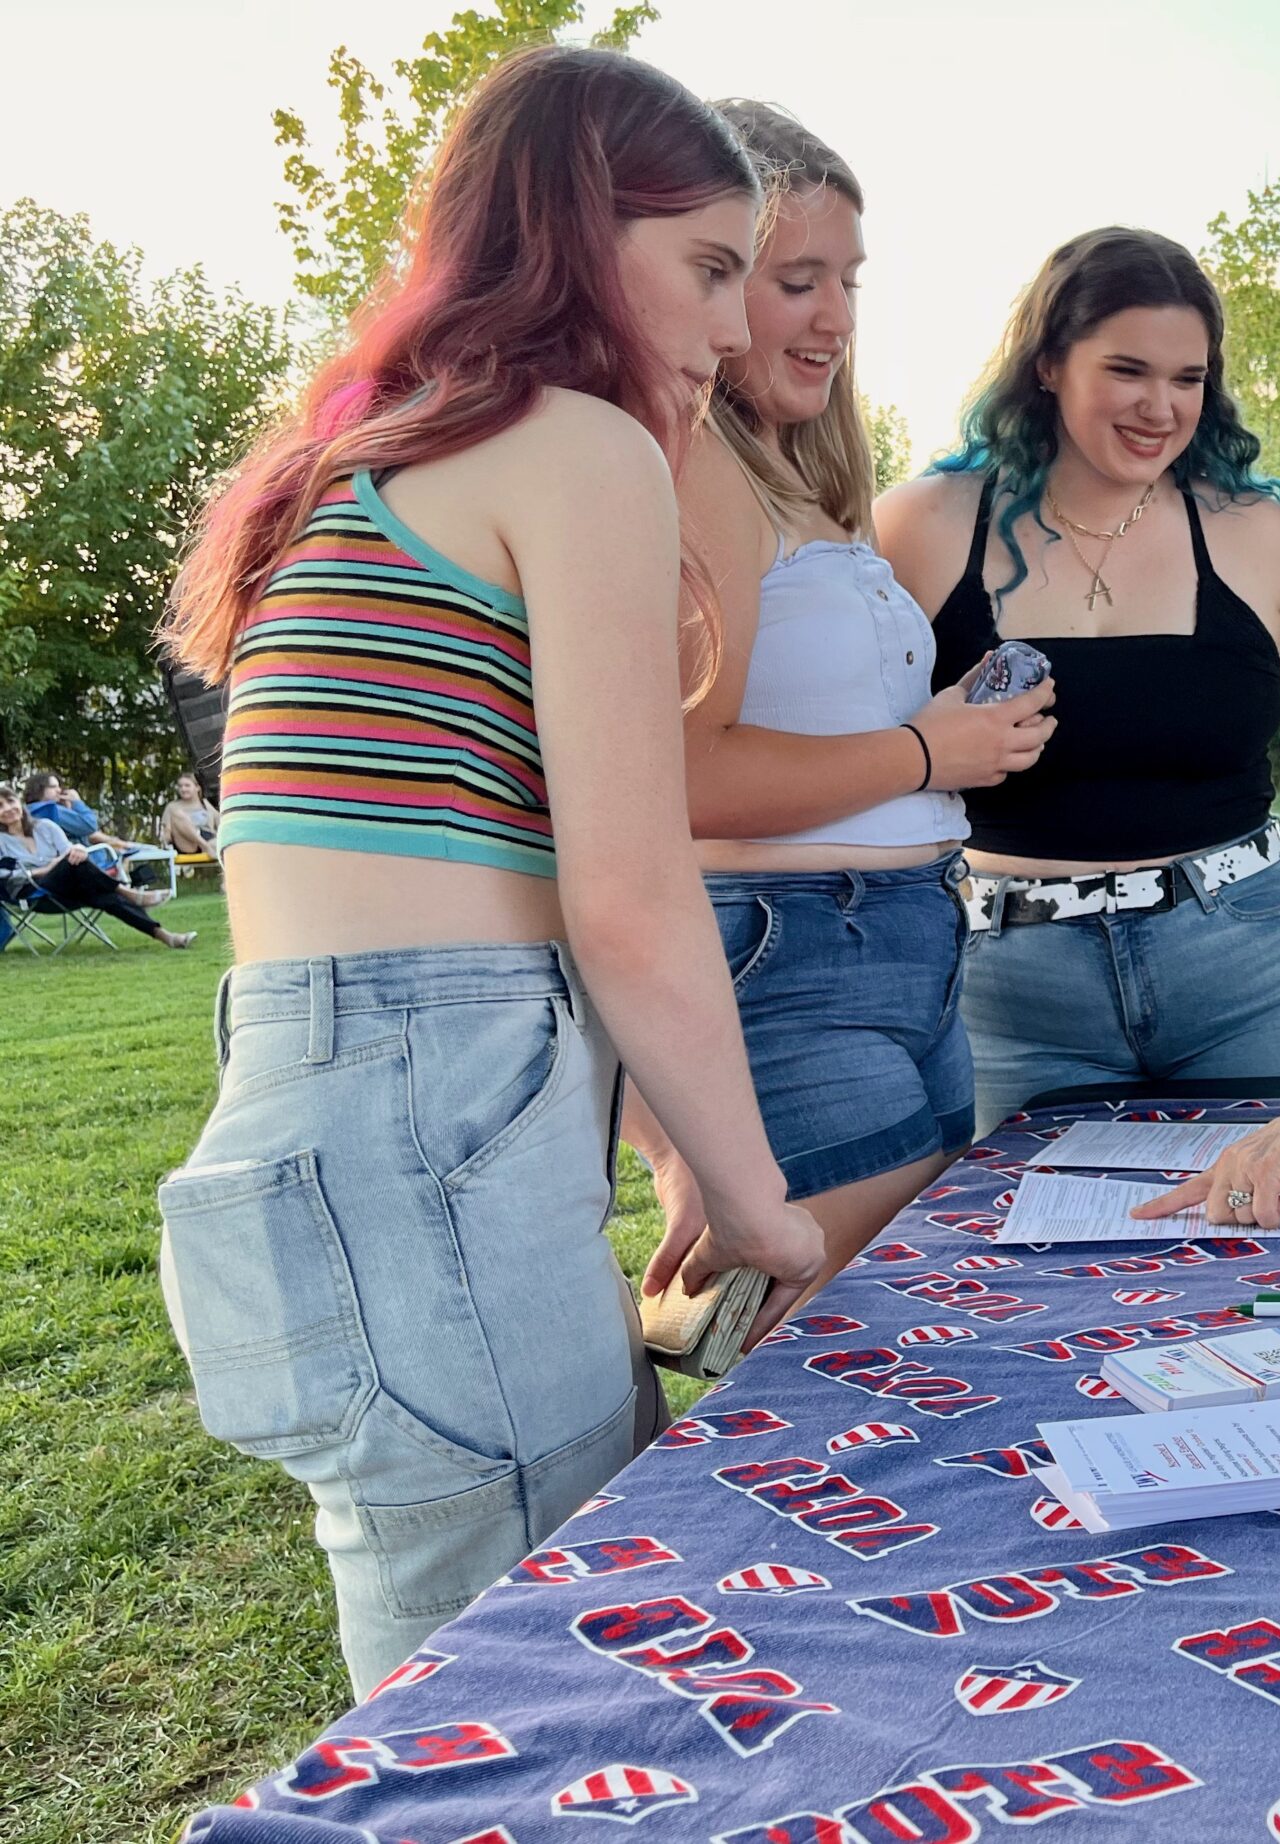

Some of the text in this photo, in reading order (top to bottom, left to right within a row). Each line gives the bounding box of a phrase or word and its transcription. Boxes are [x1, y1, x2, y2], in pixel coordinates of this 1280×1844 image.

[874, 1272, 1050, 1324] VOTE
[991, 1309, 1262, 1362] VOTE
[803, 1347, 1002, 1420] VOTE
[712, 1457, 942, 1561] VOTE
[845, 1543, 1236, 1638] VOTE
[568, 1595, 842, 1758] VOTE
